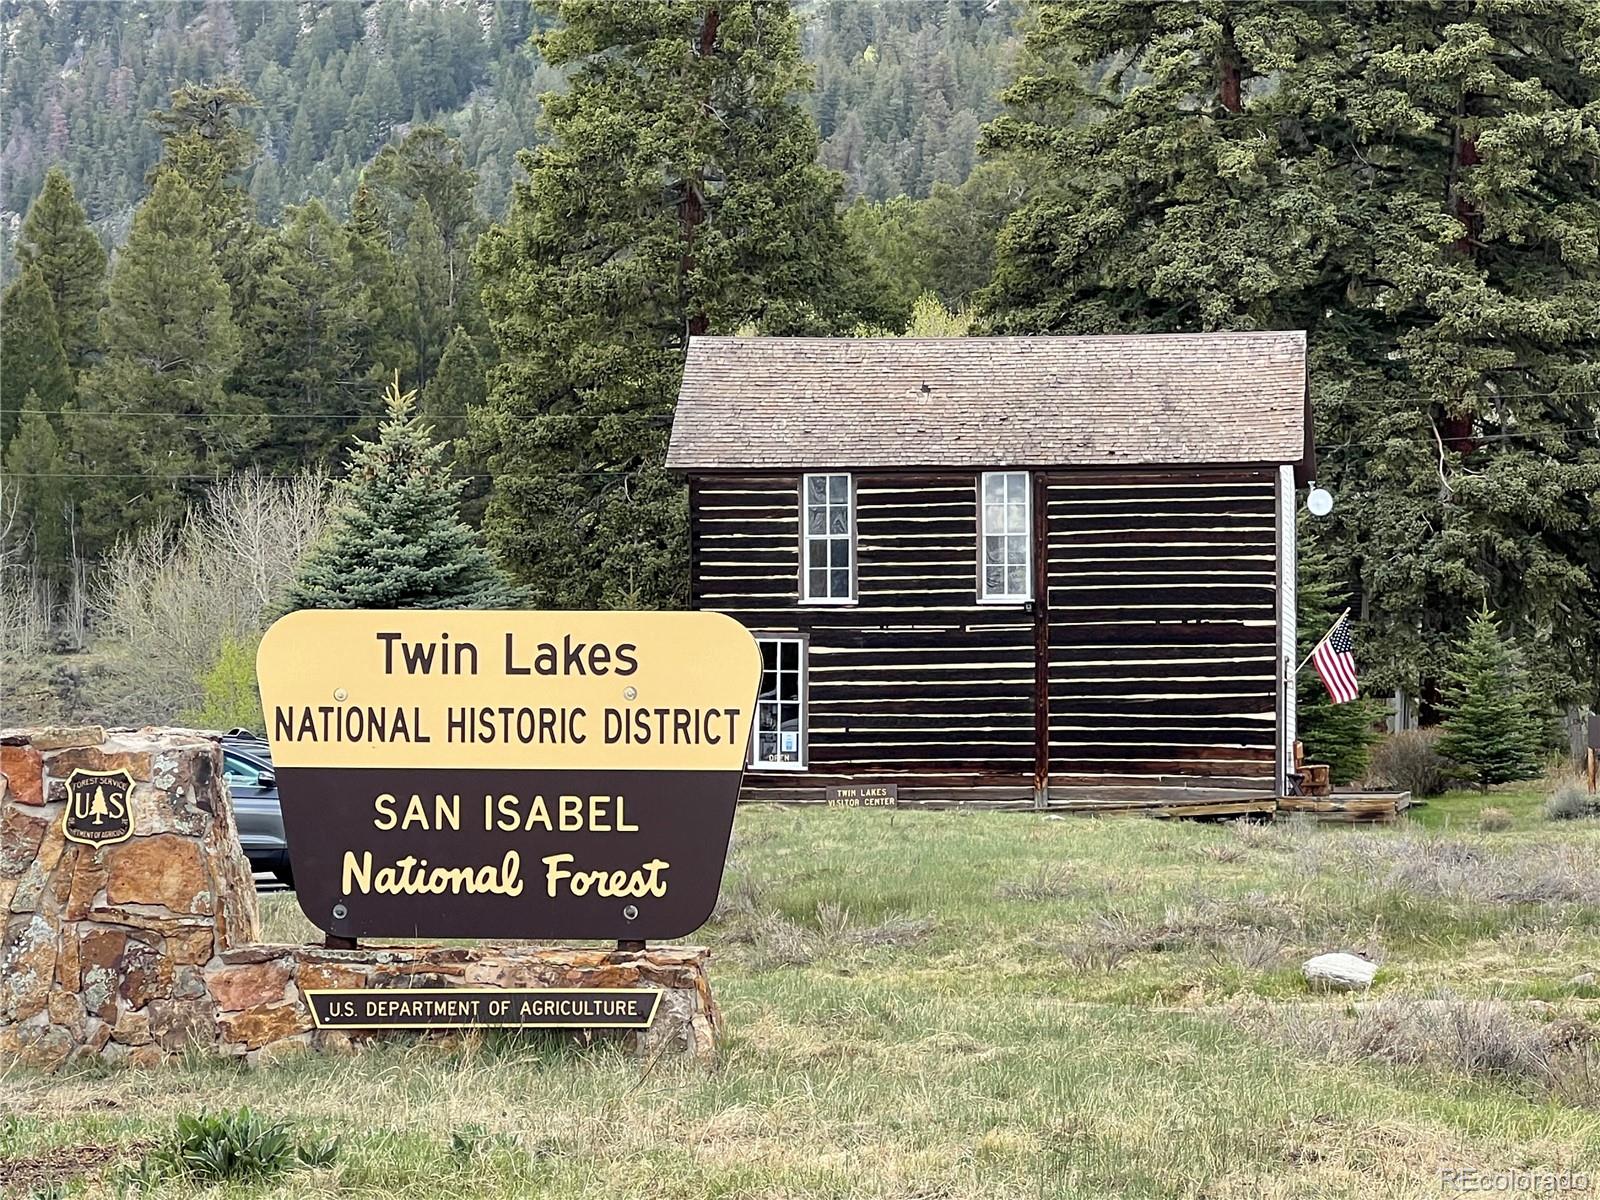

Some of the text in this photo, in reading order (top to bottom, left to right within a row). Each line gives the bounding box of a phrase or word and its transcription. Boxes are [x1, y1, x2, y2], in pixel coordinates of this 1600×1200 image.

[376, 632, 638, 677] Twin Lakes
[275, 705, 741, 745] NATIONAL HISTORIC DISTRICT
[73, 777, 127, 791] FOREST SERVICE
[837, 788, 887, 797] TWIN LAKES
[373, 793, 639, 832] SAN ISABEL
[828, 797, 895, 807] VISITOR CENTER
[342, 850, 670, 898] National Forest
[329, 1000, 637, 1017] U.S. DEPARTMENT OF AGRICULTURE
